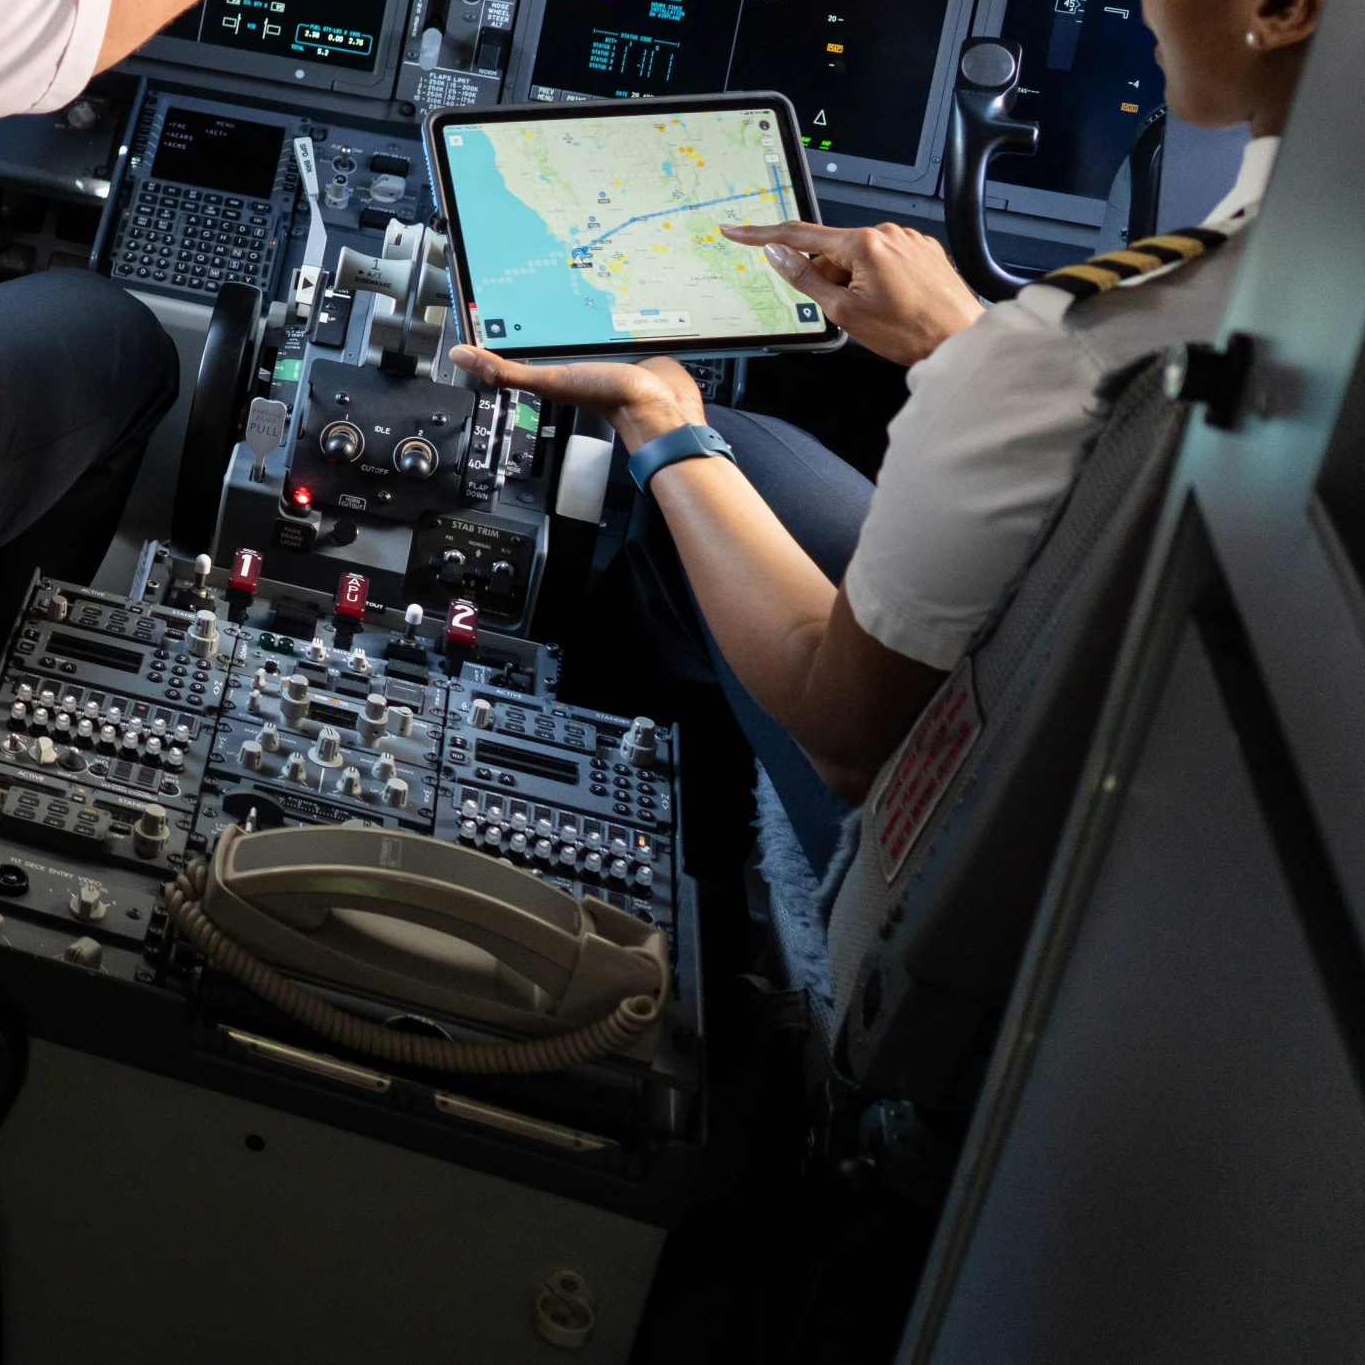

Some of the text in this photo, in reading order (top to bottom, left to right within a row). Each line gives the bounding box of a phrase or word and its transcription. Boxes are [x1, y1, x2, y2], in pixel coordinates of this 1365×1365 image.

[491, 2, 509, 10] NOSE
[488, 8, 510, 17] WHEEL
[488, 14, 510, 23] STEER
[317, 48, 329, 57] 5.2
[479, 68, 497, 76] NORM
[430, 73, 451, 81] FLAPS
[539, 87, 554, 95] PREV
[216, 121, 235, 129] MENU
[299, 143, 312, 173] SPD BRK
[372, 259, 379, 270] 1
[479, 400, 491, 408] 25
[250, 423, 277, 437] PULL
[375, 426, 391, 434] IDLE
[474, 426, 486, 435] 30
[469, 459, 481, 469] 40
[361, 465, 389, 476] CUTOFF
[469, 482, 488, 491] FLAP
[466, 490, 488, 499] DOWN
[341, 501, 363, 510] CUTOUT
[452, 521, 499, 538] STAB TRIM
[280, 540, 301, 548] LIGHT
[469, 540, 491, 549] NORMAL
[240, 555, 251, 577] 1
[81, 588, 105, 597] ACTIVE
[347, 578, 361, 602] APU
[452, 605, 475, 630] 2
[496, 689, 522, 699] ACTIVE
[595, 713, 631, 724] STANDBY
[18, 770, 44, 781] ACTIVE
[11, 857, 102, 887] FLT DECK ENTRY VIDEO
